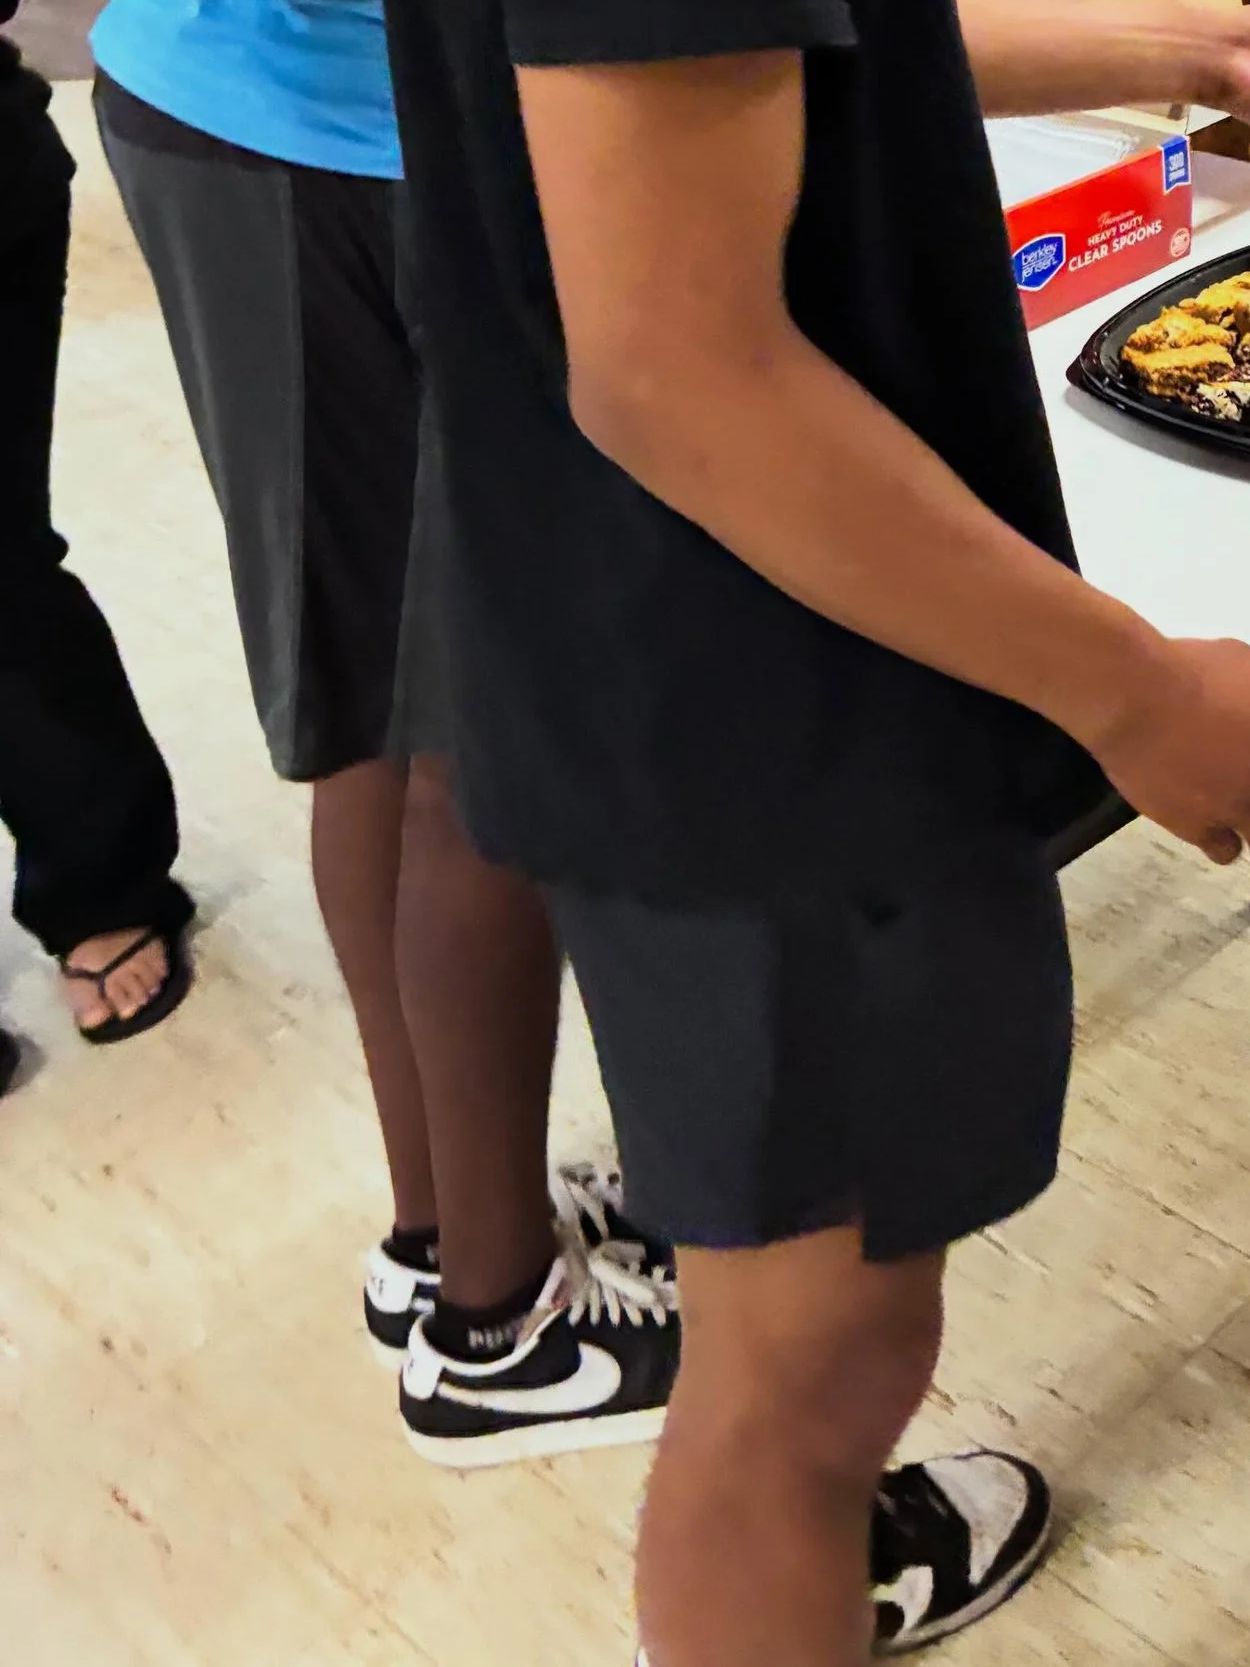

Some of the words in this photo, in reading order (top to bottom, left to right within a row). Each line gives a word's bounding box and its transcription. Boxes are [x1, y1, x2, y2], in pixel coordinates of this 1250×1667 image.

[1068, 244, 1109, 272] CLEAR
[1112, 220, 1162, 253] SPOONS
[1088, 226, 1117, 247] HEAVY
[1120, 215, 1143, 233] DUTY
[1022, 242, 1058, 265] berkley
